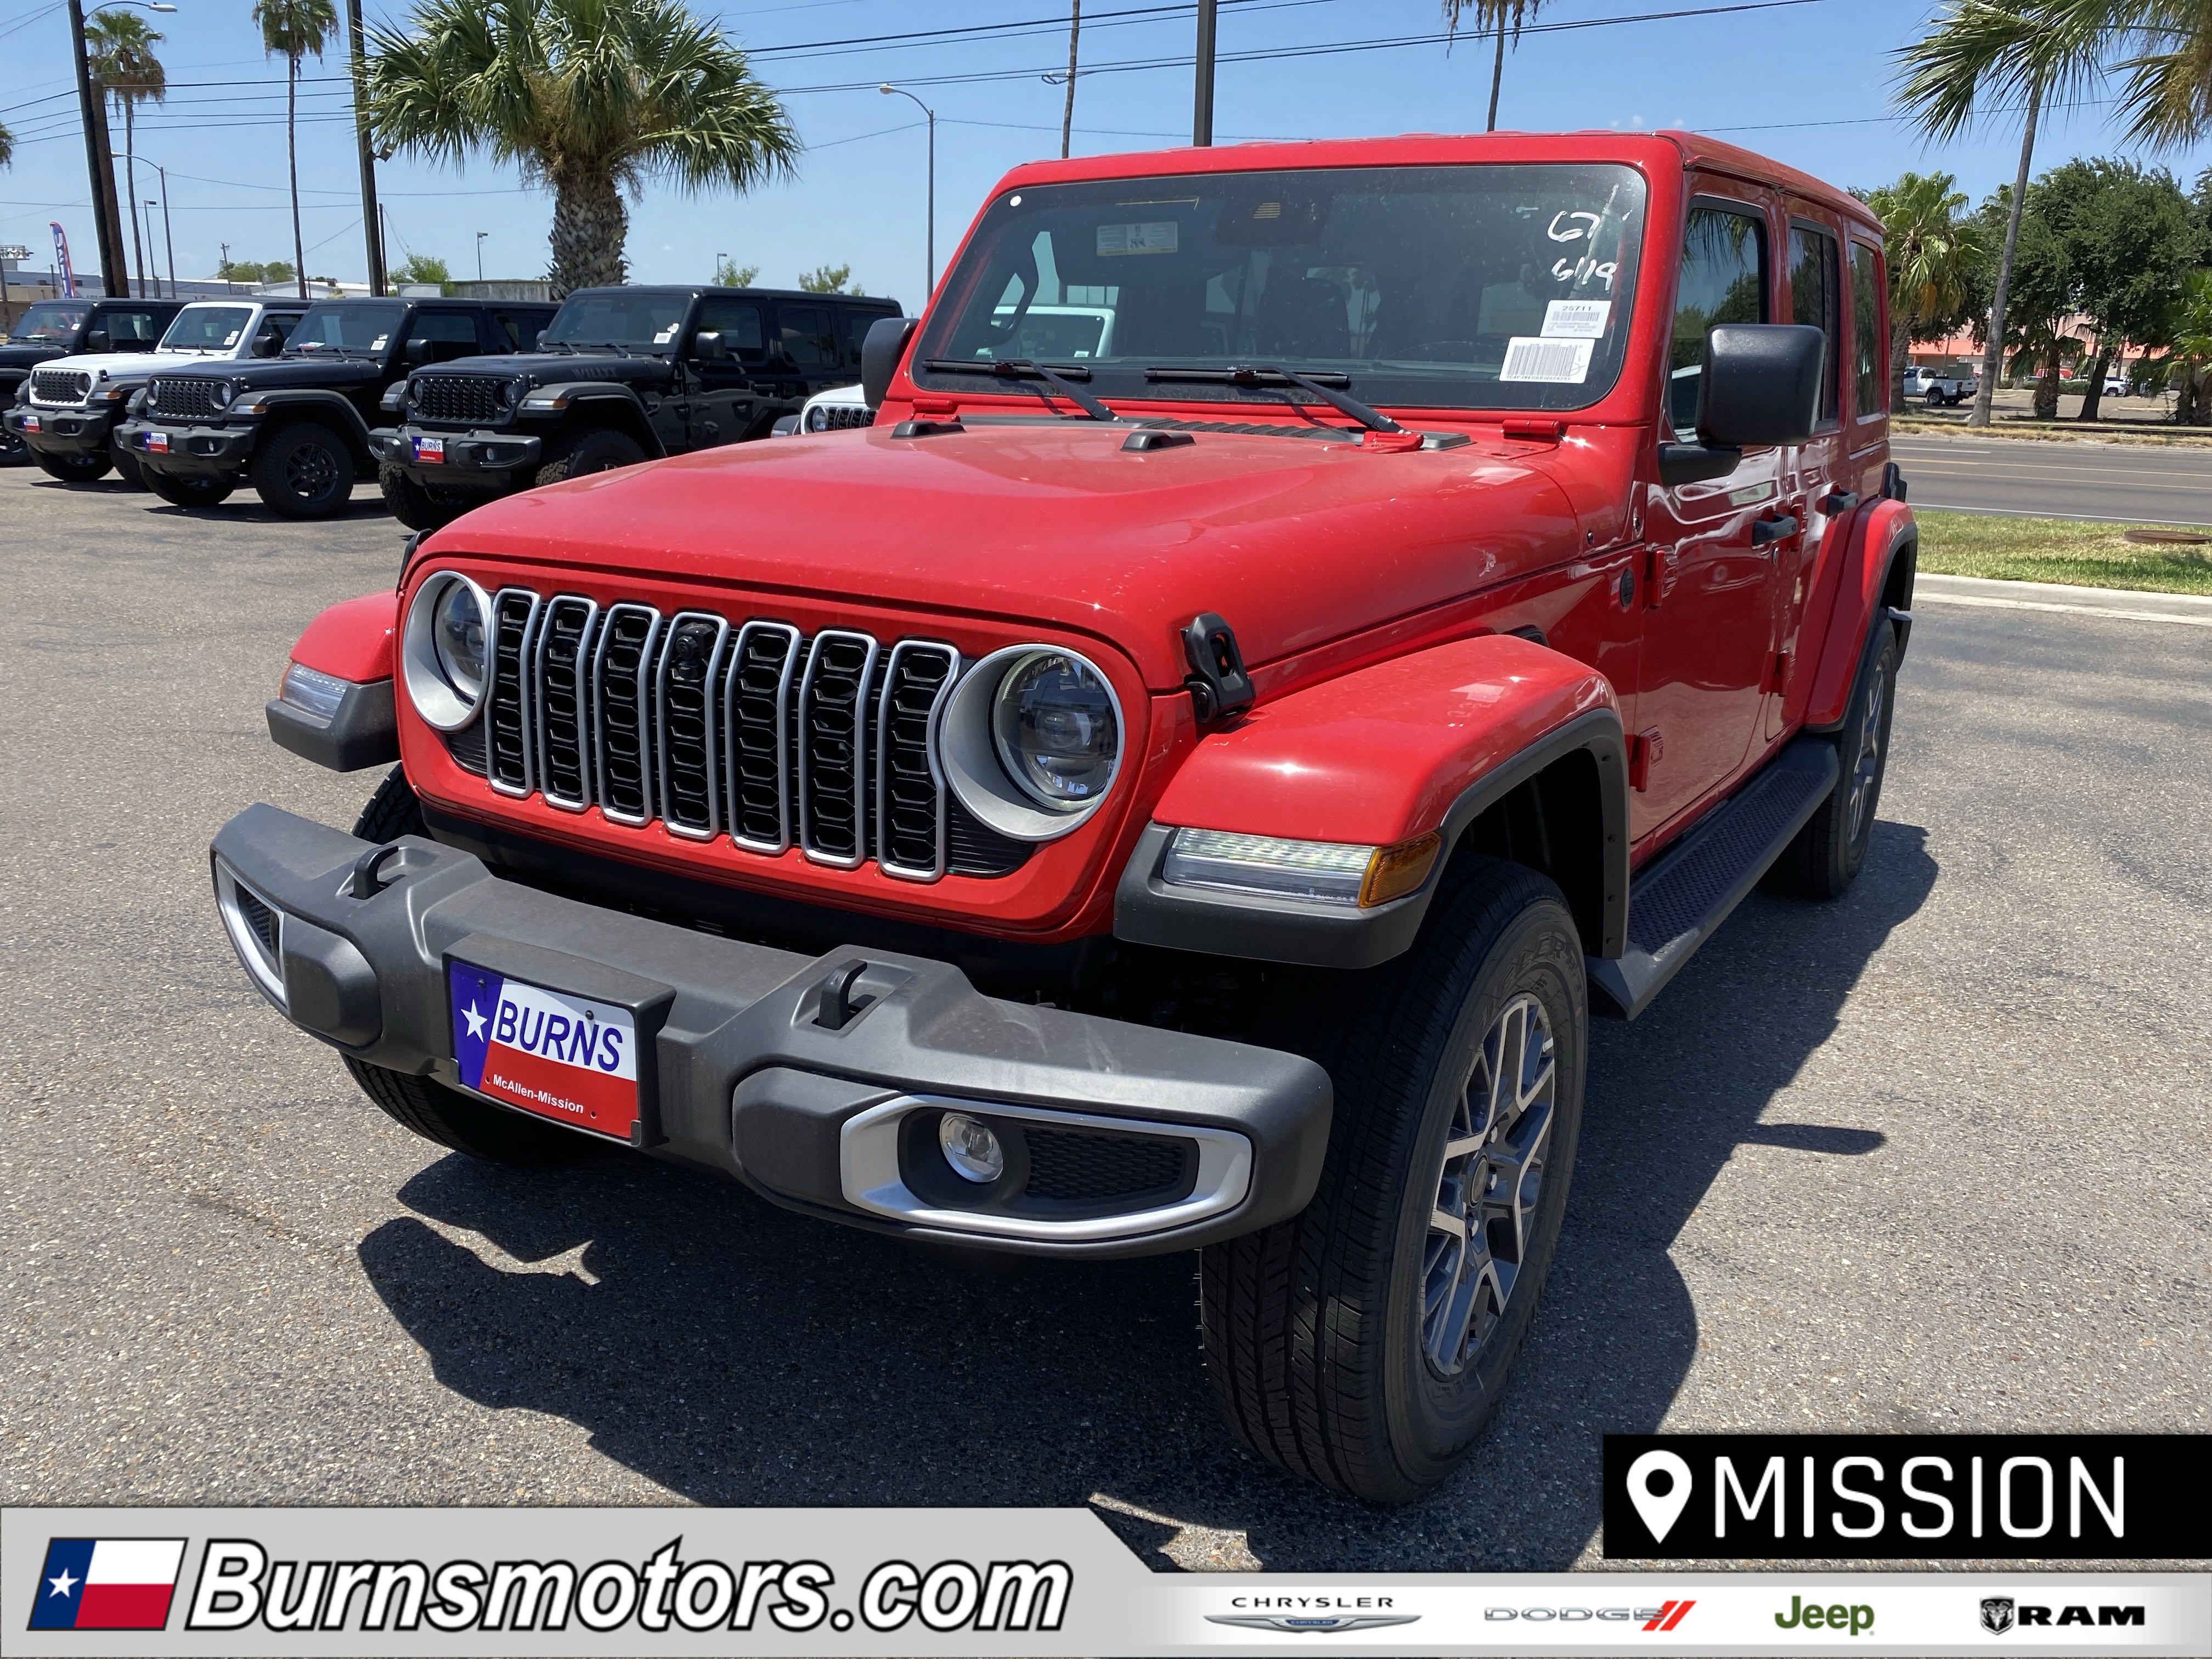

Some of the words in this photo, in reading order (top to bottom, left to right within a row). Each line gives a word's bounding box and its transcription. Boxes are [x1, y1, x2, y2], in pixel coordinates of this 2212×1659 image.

[421, 441, 441, 450] BURNS
[496, 999, 623, 1072] BURNS
[493, 1074, 584, 1114] McAllen-Mission
